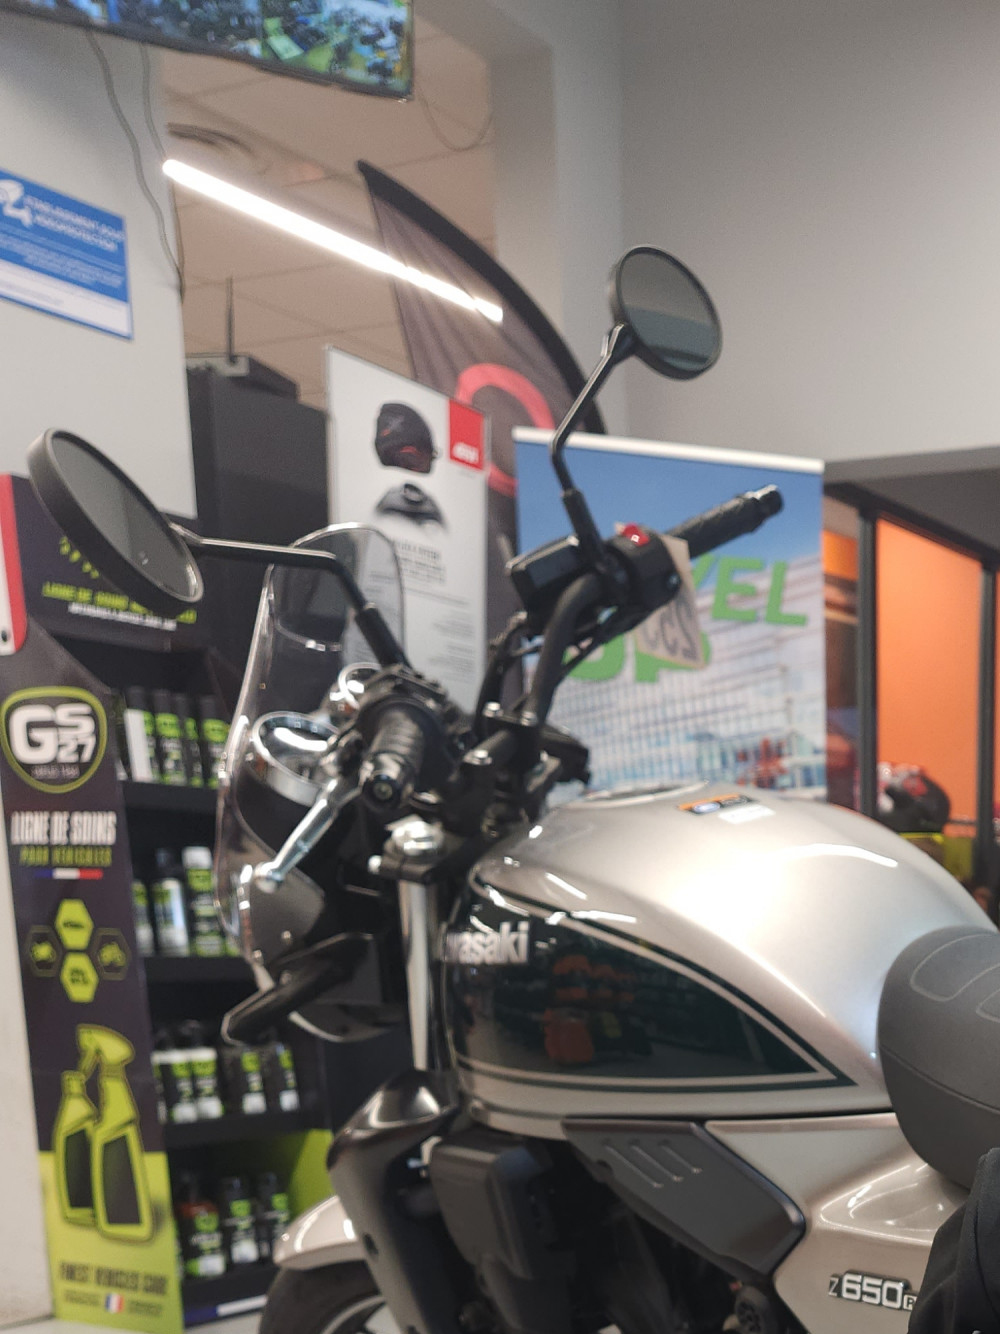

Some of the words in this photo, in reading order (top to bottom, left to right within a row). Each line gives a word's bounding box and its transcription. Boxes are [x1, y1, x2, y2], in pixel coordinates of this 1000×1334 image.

[11, 811, 50, 845] LIGNE
[51, 811, 69, 845] DE
[69, 811, 117, 845] SOINS
